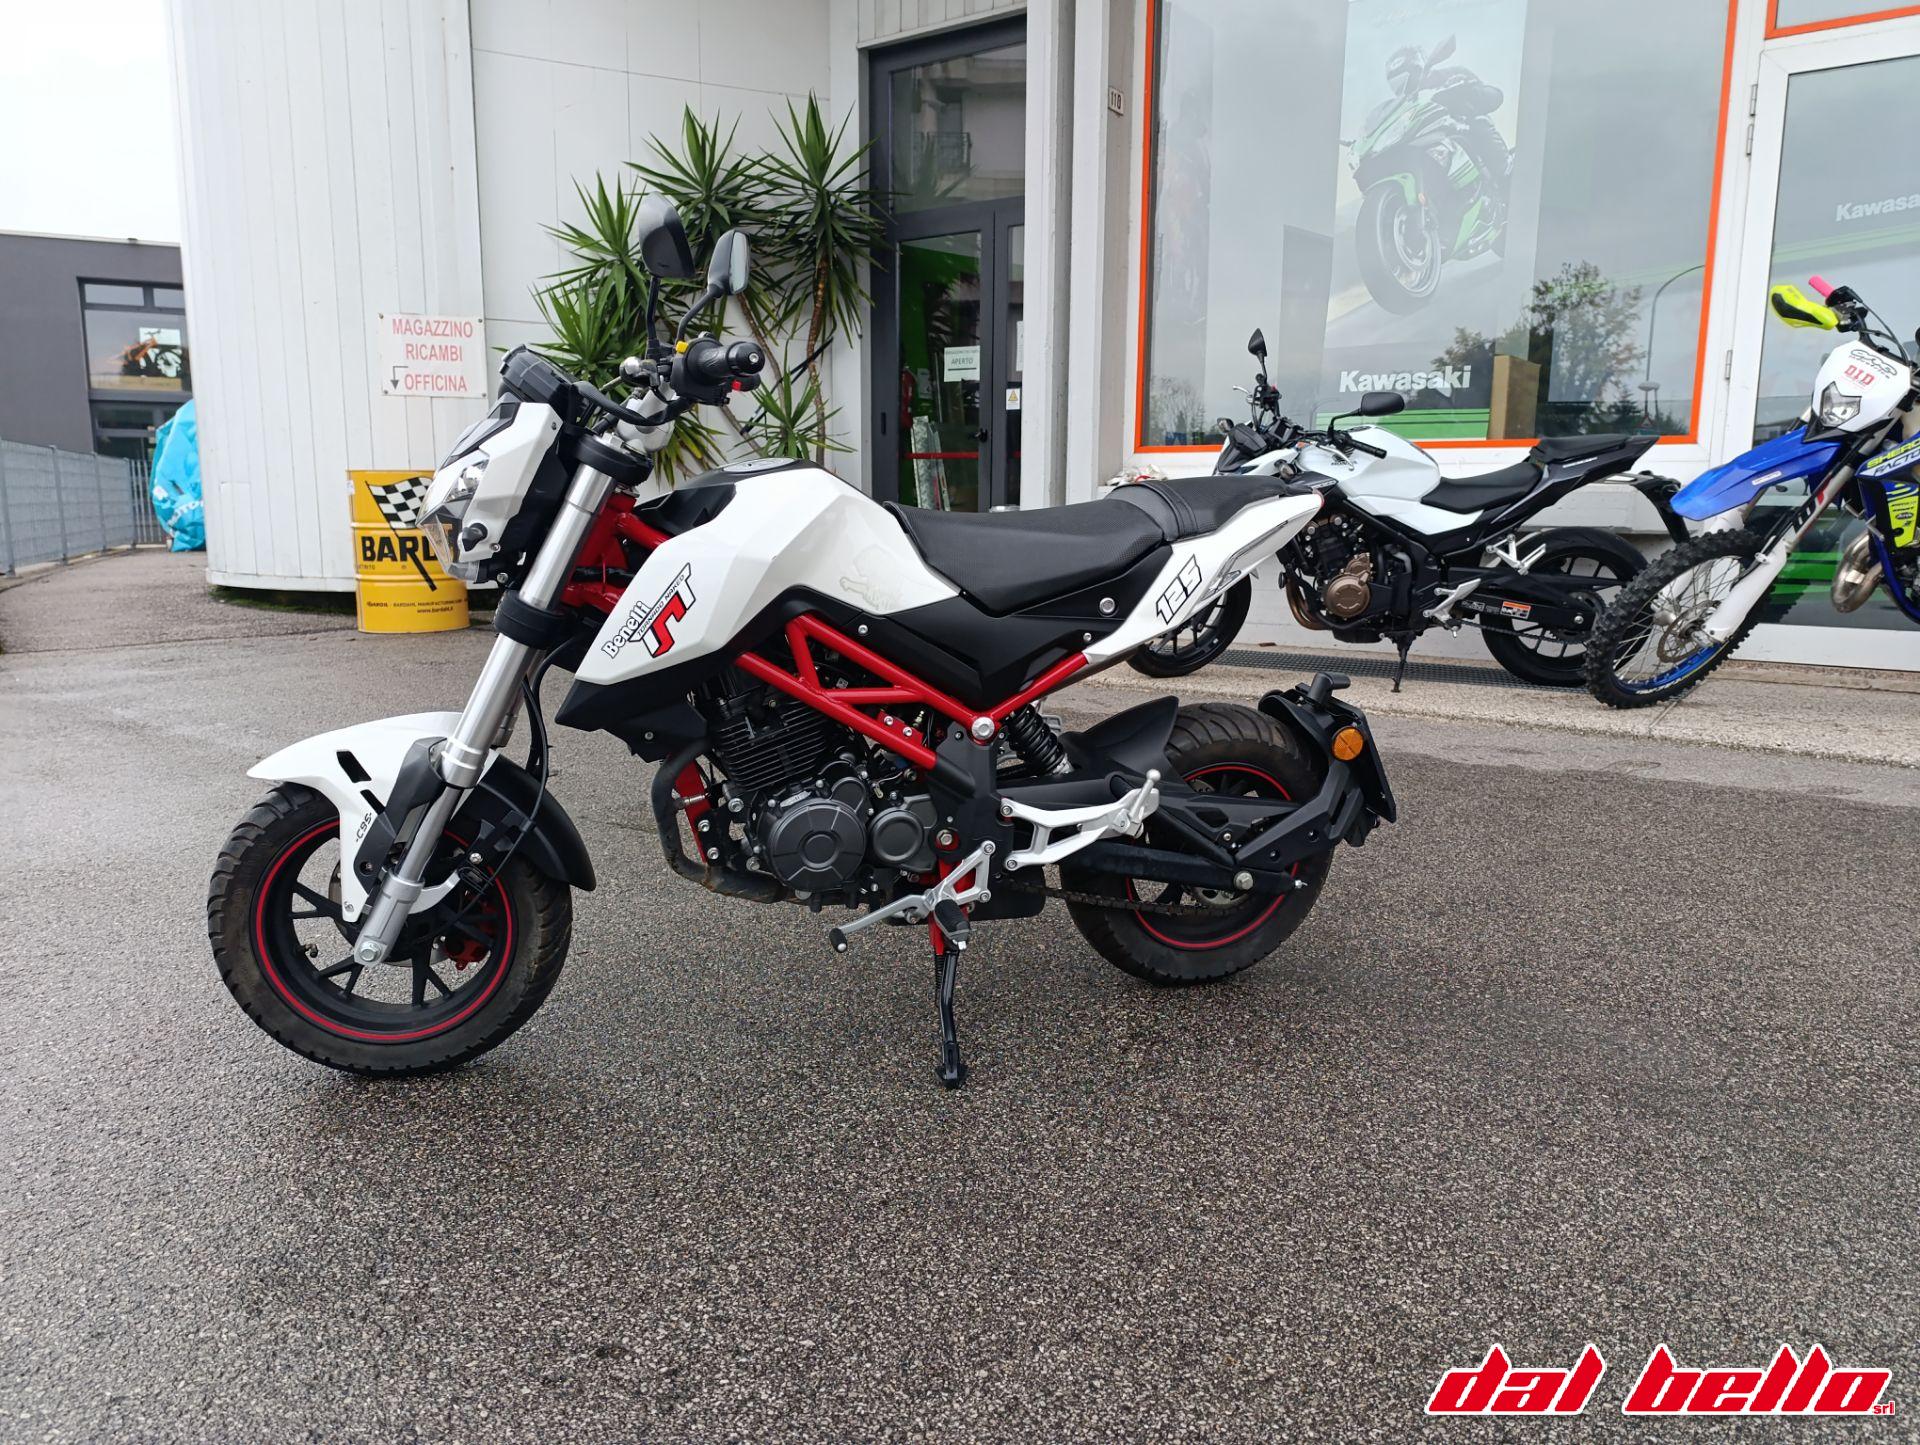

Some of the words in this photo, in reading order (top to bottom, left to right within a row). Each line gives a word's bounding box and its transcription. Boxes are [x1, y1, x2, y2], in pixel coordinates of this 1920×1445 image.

[392, 318, 473, 338] MAGAZZINO
[405, 343, 463, 362] RICAMBI
[951, 357, 974, 366] APERTO
[404, 373, 468, 392] OFFICINA
[1339, 365, 1472, 393] Kawasaki
[1156, 553, 1202, 625] 125
[637, 601, 665, 636] TORNADO
[664, 575, 685, 601] NAKED
[601, 600, 653, 659] Benelli
